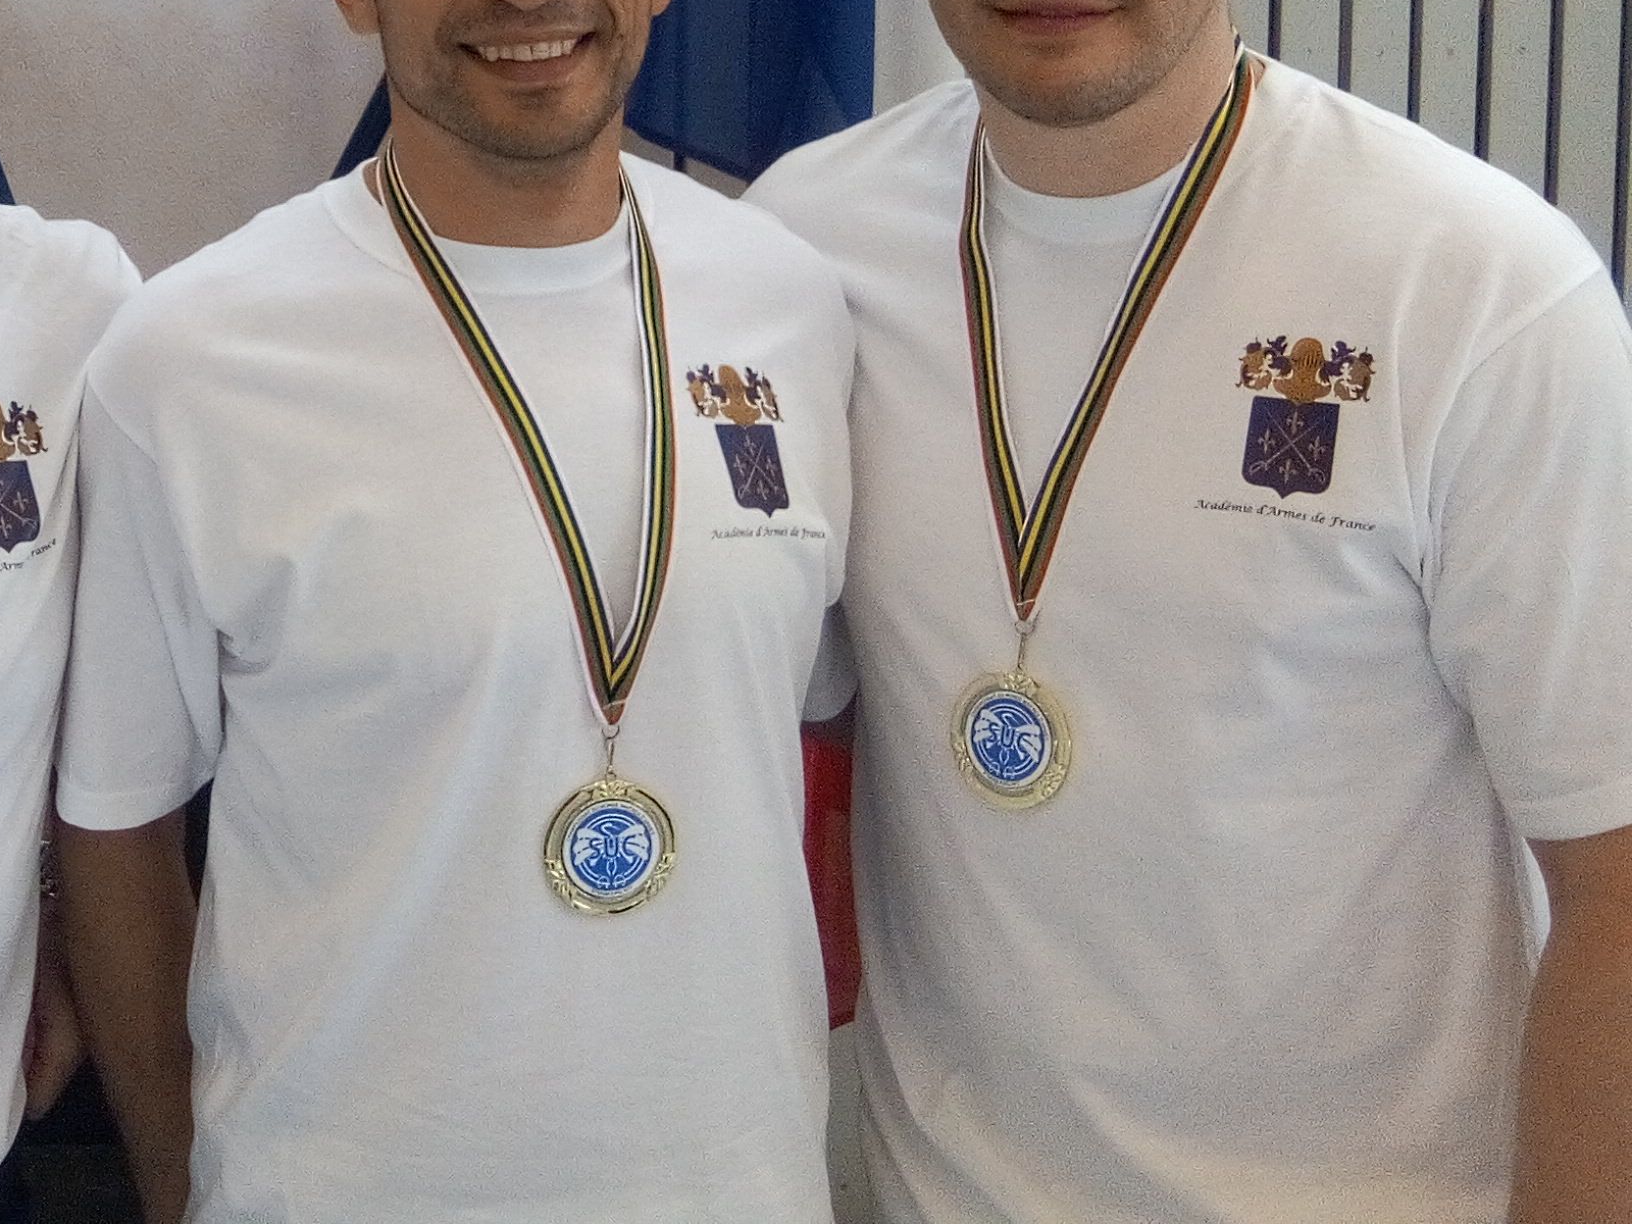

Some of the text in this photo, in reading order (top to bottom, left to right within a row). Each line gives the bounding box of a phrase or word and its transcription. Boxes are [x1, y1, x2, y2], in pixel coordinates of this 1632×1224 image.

[1256, 504, 1306, 521] d'Armes
[1311, 512, 1325, 524] de
[1328, 516, 1376, 531] France
